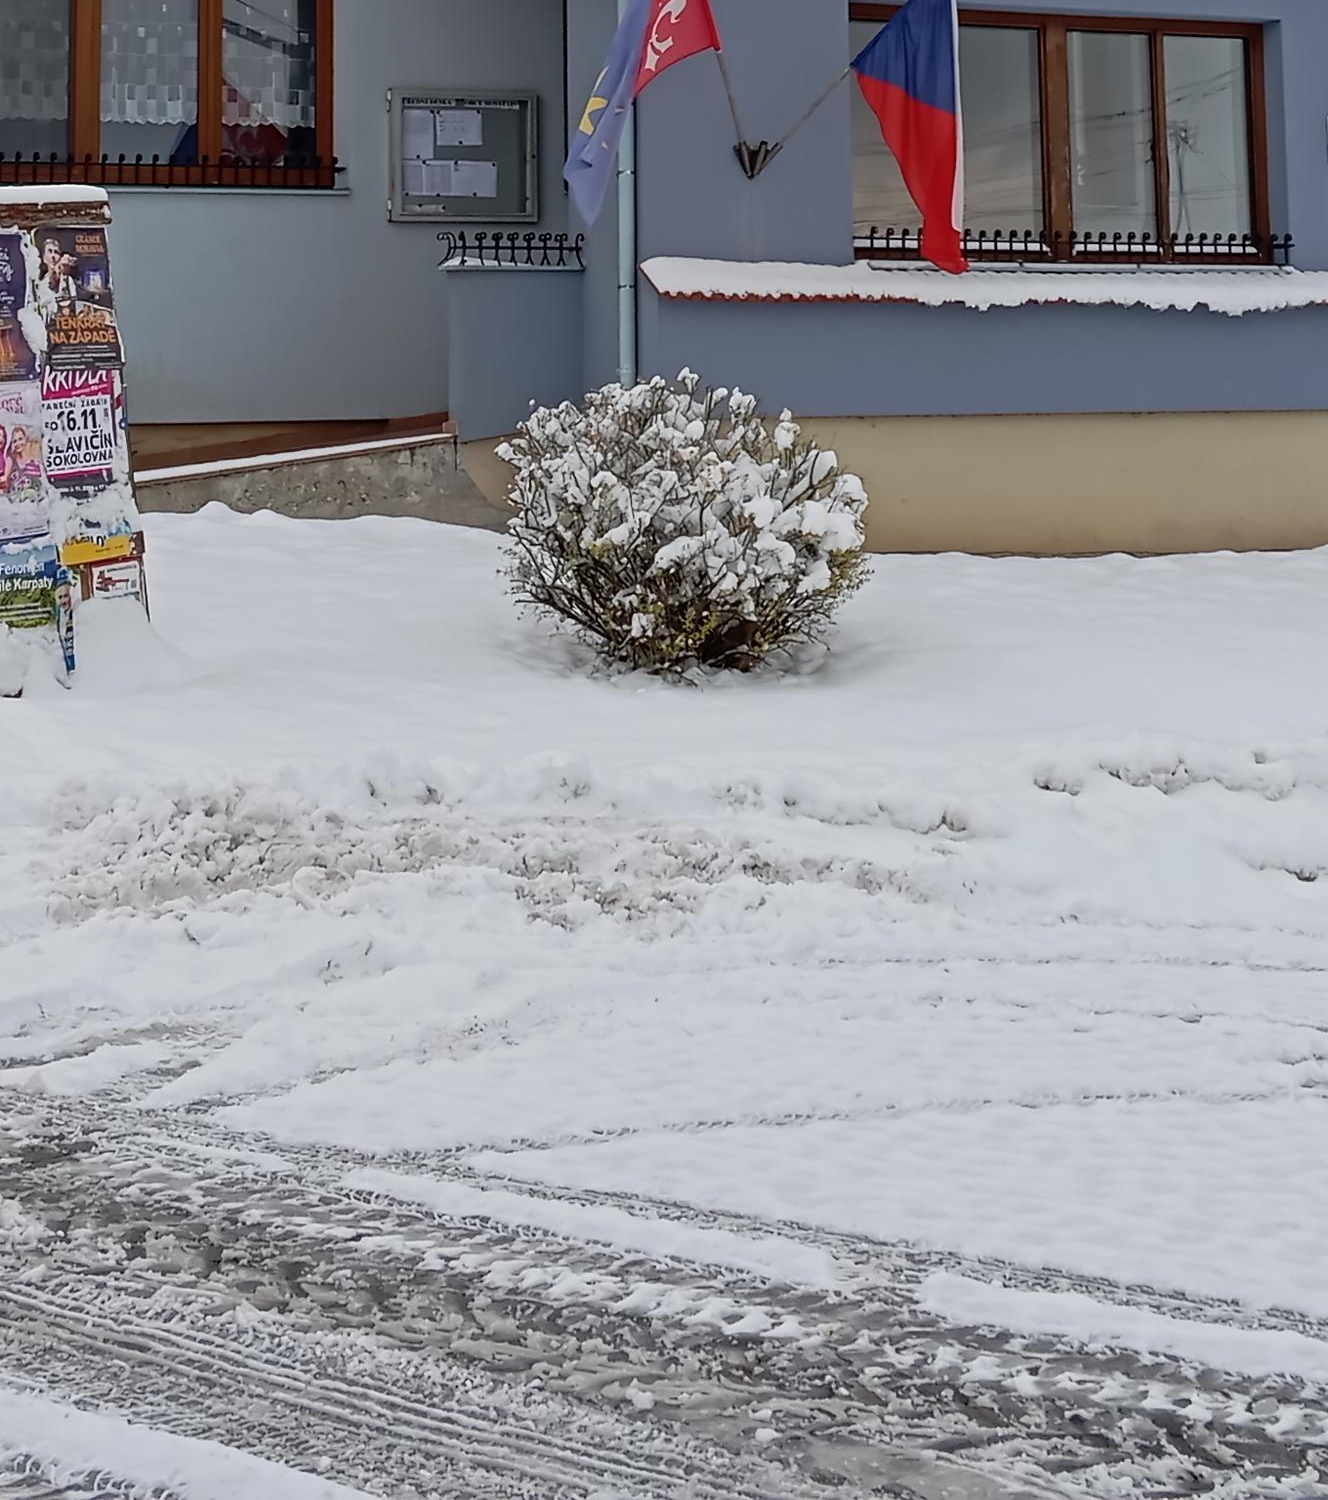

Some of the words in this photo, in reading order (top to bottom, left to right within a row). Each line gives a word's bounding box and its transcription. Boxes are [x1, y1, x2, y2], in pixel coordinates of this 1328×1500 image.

[49, 331, 68, 344] NA
[69, 328, 117, 344] ZÁPADĚ
[47, 429, 113, 455] SLAVIČÍN
[46, 448, 114, 468] SOKOLOVNA
[13, 575, 54, 592] Karpaty
